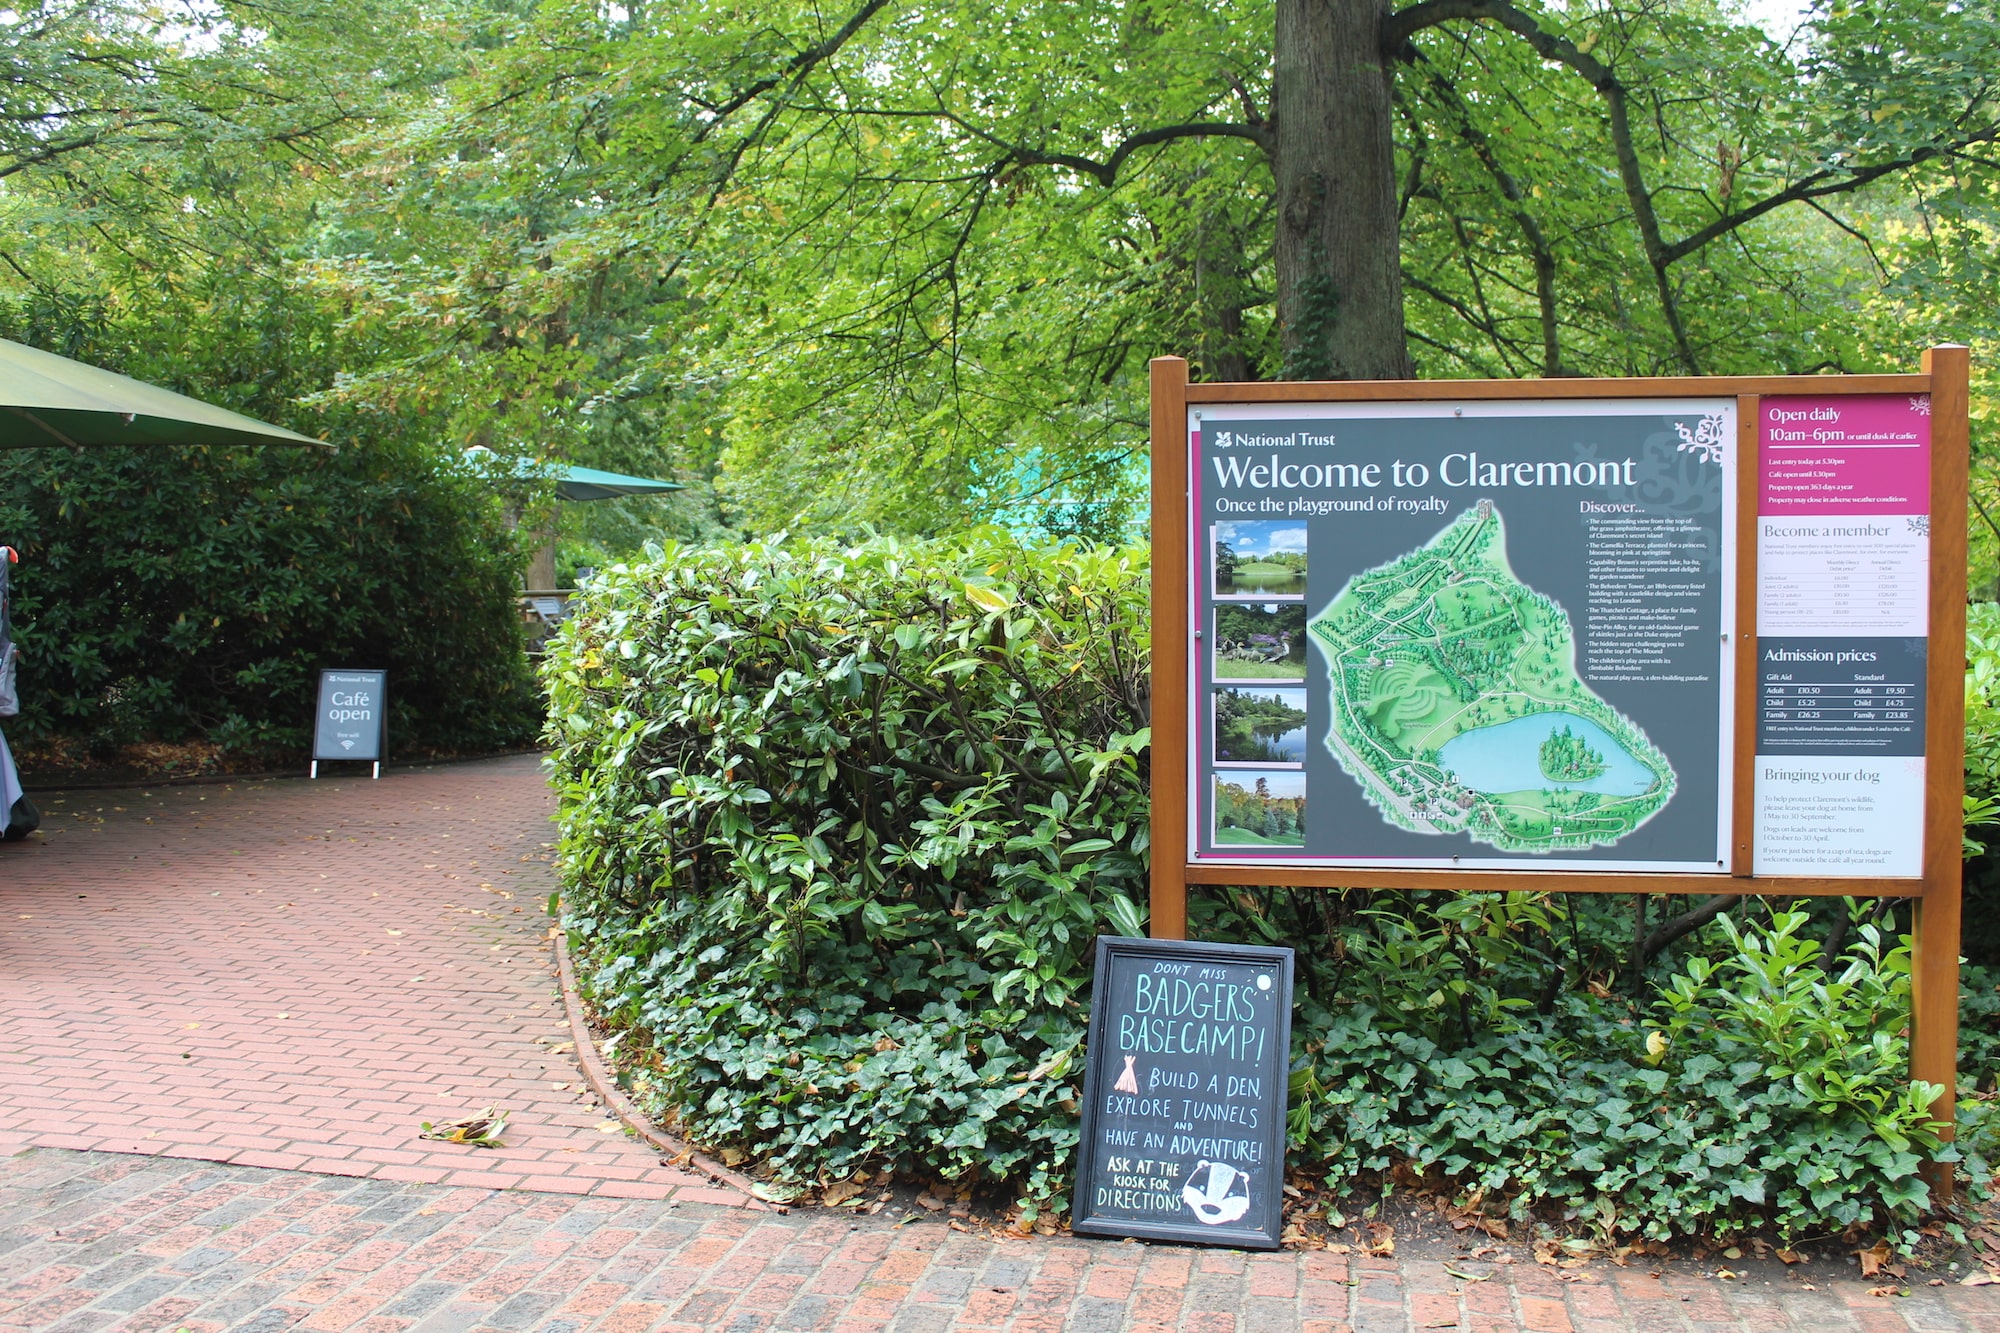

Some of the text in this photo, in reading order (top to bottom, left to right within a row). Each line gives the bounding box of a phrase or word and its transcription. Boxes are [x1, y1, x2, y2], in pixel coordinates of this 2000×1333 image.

[1769, 408, 1840, 424] Open daily
[1235, 433, 1335, 446] National Trust
[1212, 452, 1636, 488] Welcome to Claremont
[1215, 496, 1448, 515] Once the playground of royalty
[1764, 525, 1818, 536] Become
[1834, 524, 1890, 536] member
[1764, 648, 1876, 664] Admission prices
[331, 692, 369, 706] Café
[329, 710, 370, 723] open
[1765, 769, 1880, 784] Bringing your dog
[1199, 968, 1226, 980] MISS
[1120, 1014, 1266, 1068] BASECAMP!
[1150, 1068, 1262, 1100] BUILD A DEN,
[1106, 1095, 1258, 1128] EXPLORE TUNNELS
[1174, 1122, 1193, 1132] AND
[1106, 1128, 1262, 1165] HAVE AN ADVENTURE!
[1107, 1156, 1180, 1177] ASK AT THE
[1113, 1174, 1170, 1191] KIOSK FOR
[1098, 1188, 1182, 1211] DIRECTIONS
